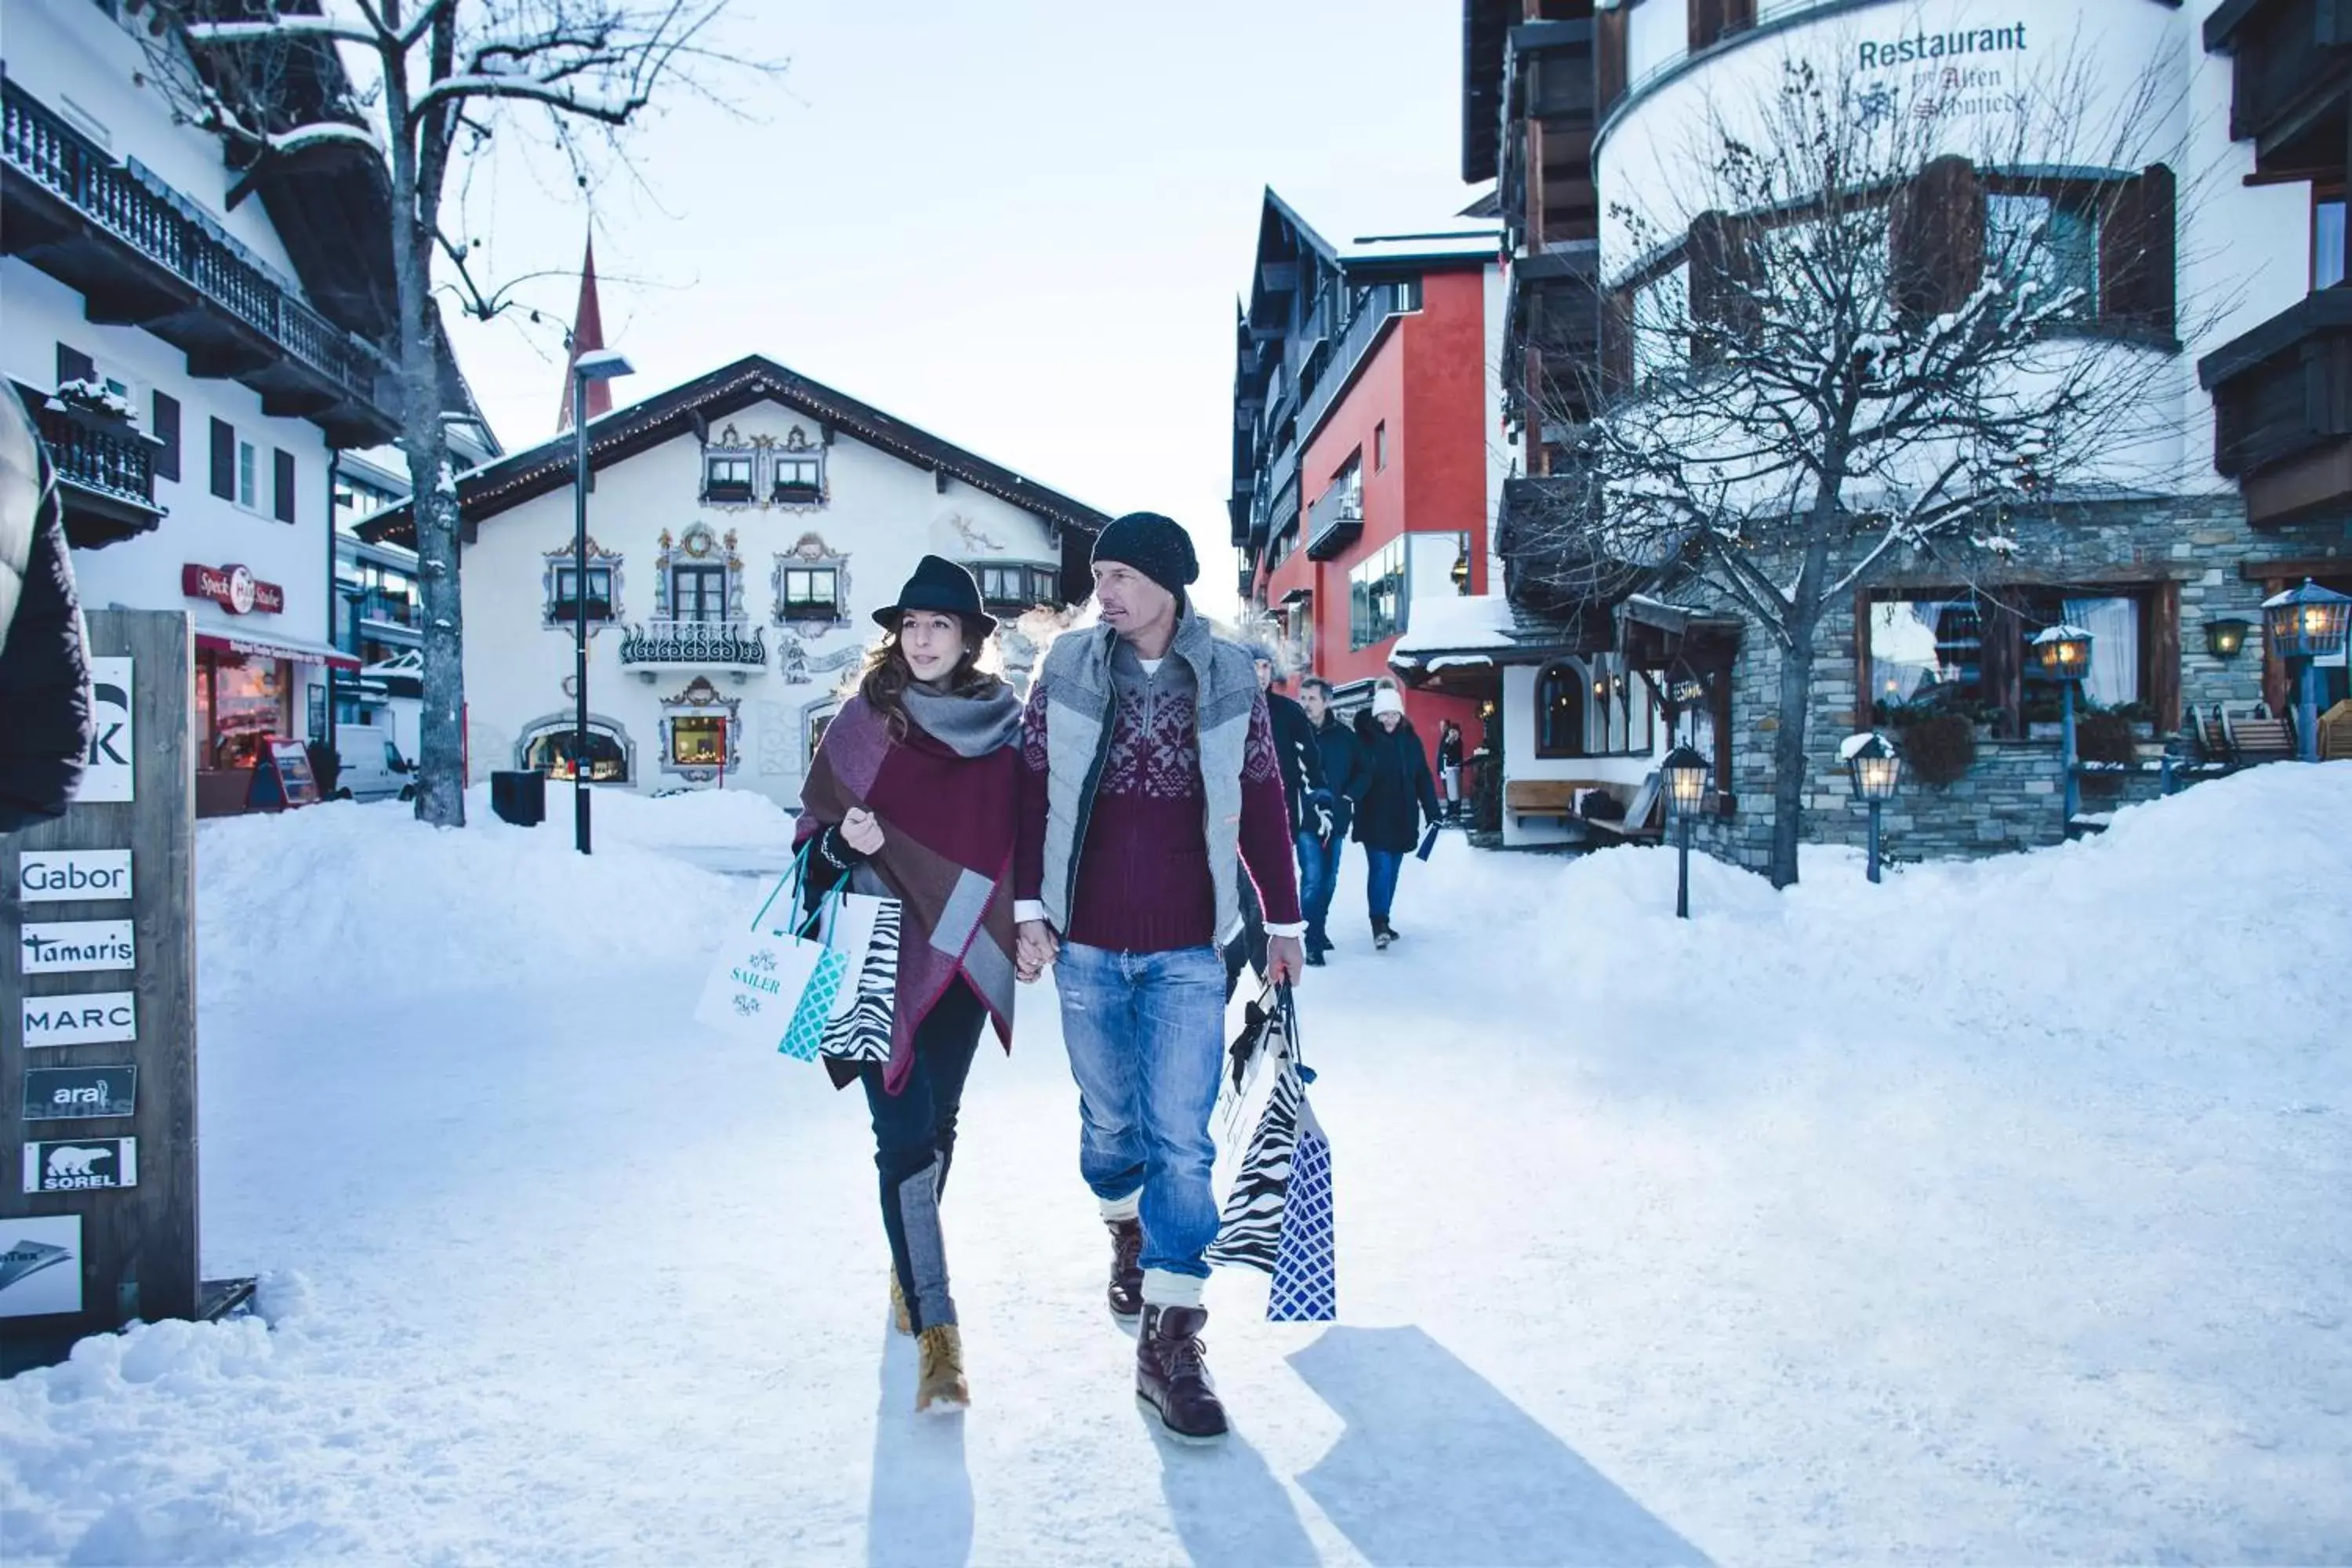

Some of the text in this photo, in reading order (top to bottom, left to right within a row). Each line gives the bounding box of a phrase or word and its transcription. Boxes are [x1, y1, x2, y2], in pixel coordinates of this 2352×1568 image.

[1859, 20, 2027, 71] Restaurant
[1941, 67, 2002, 89] Alten
[22, 862, 125, 890] Gabor
[26, 1007, 132, 1032] MARC
[53, 1087, 98, 1104] ara
[44, 1175, 116, 1190] SOREL
